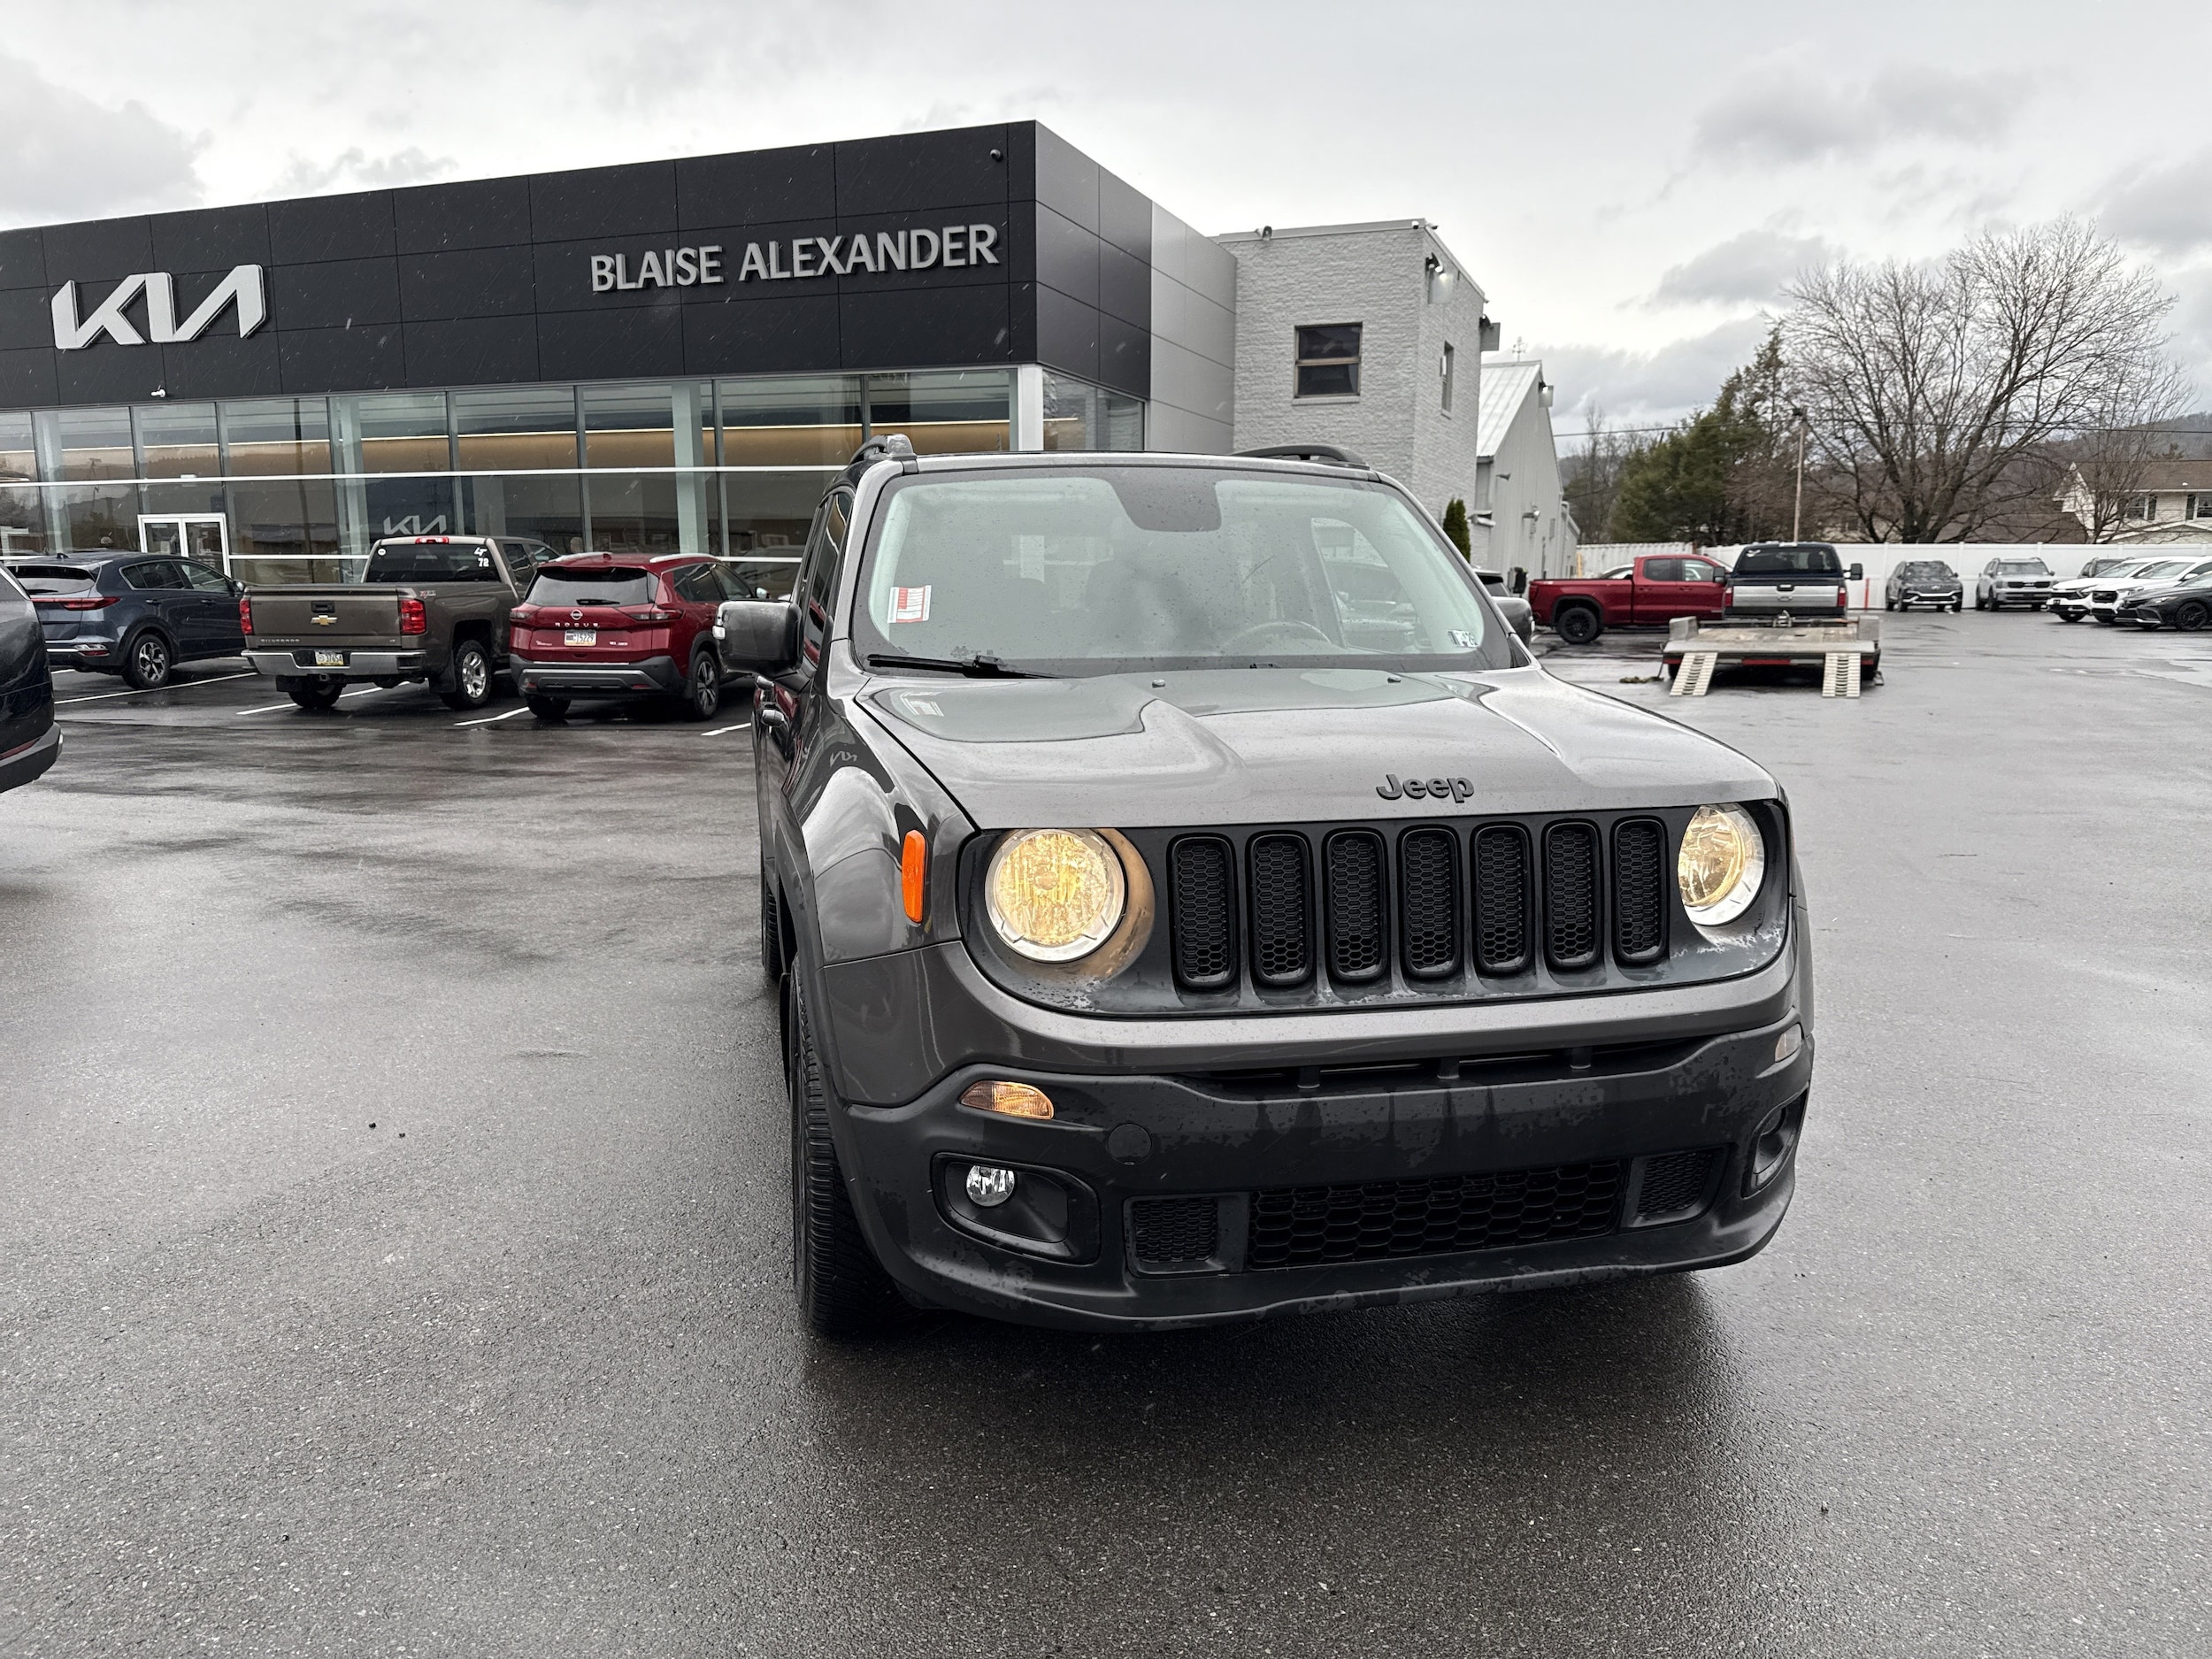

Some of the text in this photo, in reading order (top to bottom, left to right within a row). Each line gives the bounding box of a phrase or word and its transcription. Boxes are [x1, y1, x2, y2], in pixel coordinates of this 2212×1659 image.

[591, 223, 1000, 292] BLAISE ALEXANDER
[51, 264, 265, 349] KIA
[383, 515, 447, 535] KIA
[478, 557, 489, 567] 72
[1376, 774, 1474, 803] Jeep
